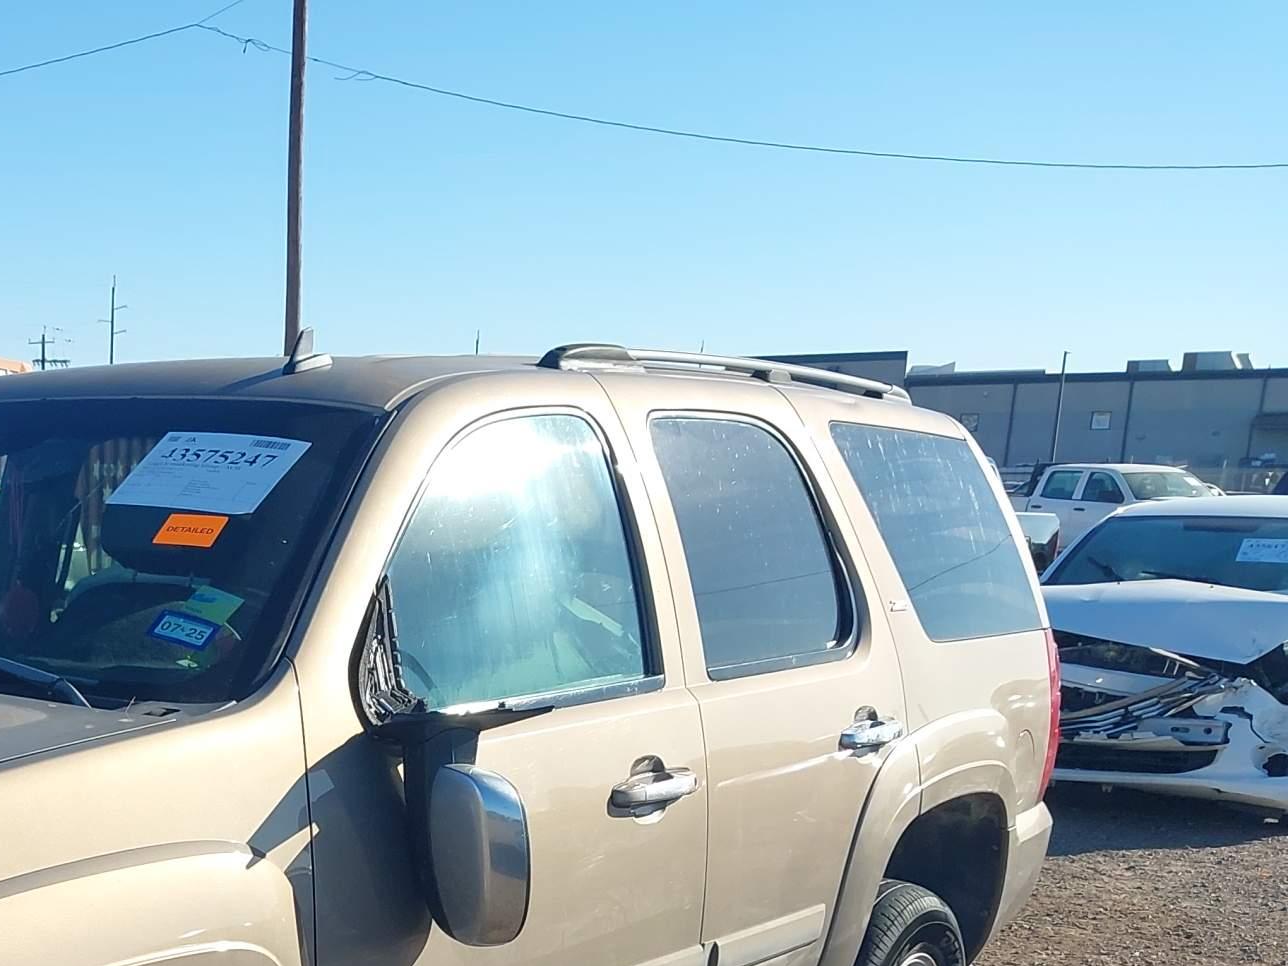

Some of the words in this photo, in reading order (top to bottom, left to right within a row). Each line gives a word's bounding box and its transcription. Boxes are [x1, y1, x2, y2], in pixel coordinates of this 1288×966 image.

[166, 526, 214, 535] DETAILED
[160, 621, 182, 633] 07
[185, 627, 207, 641] 25
